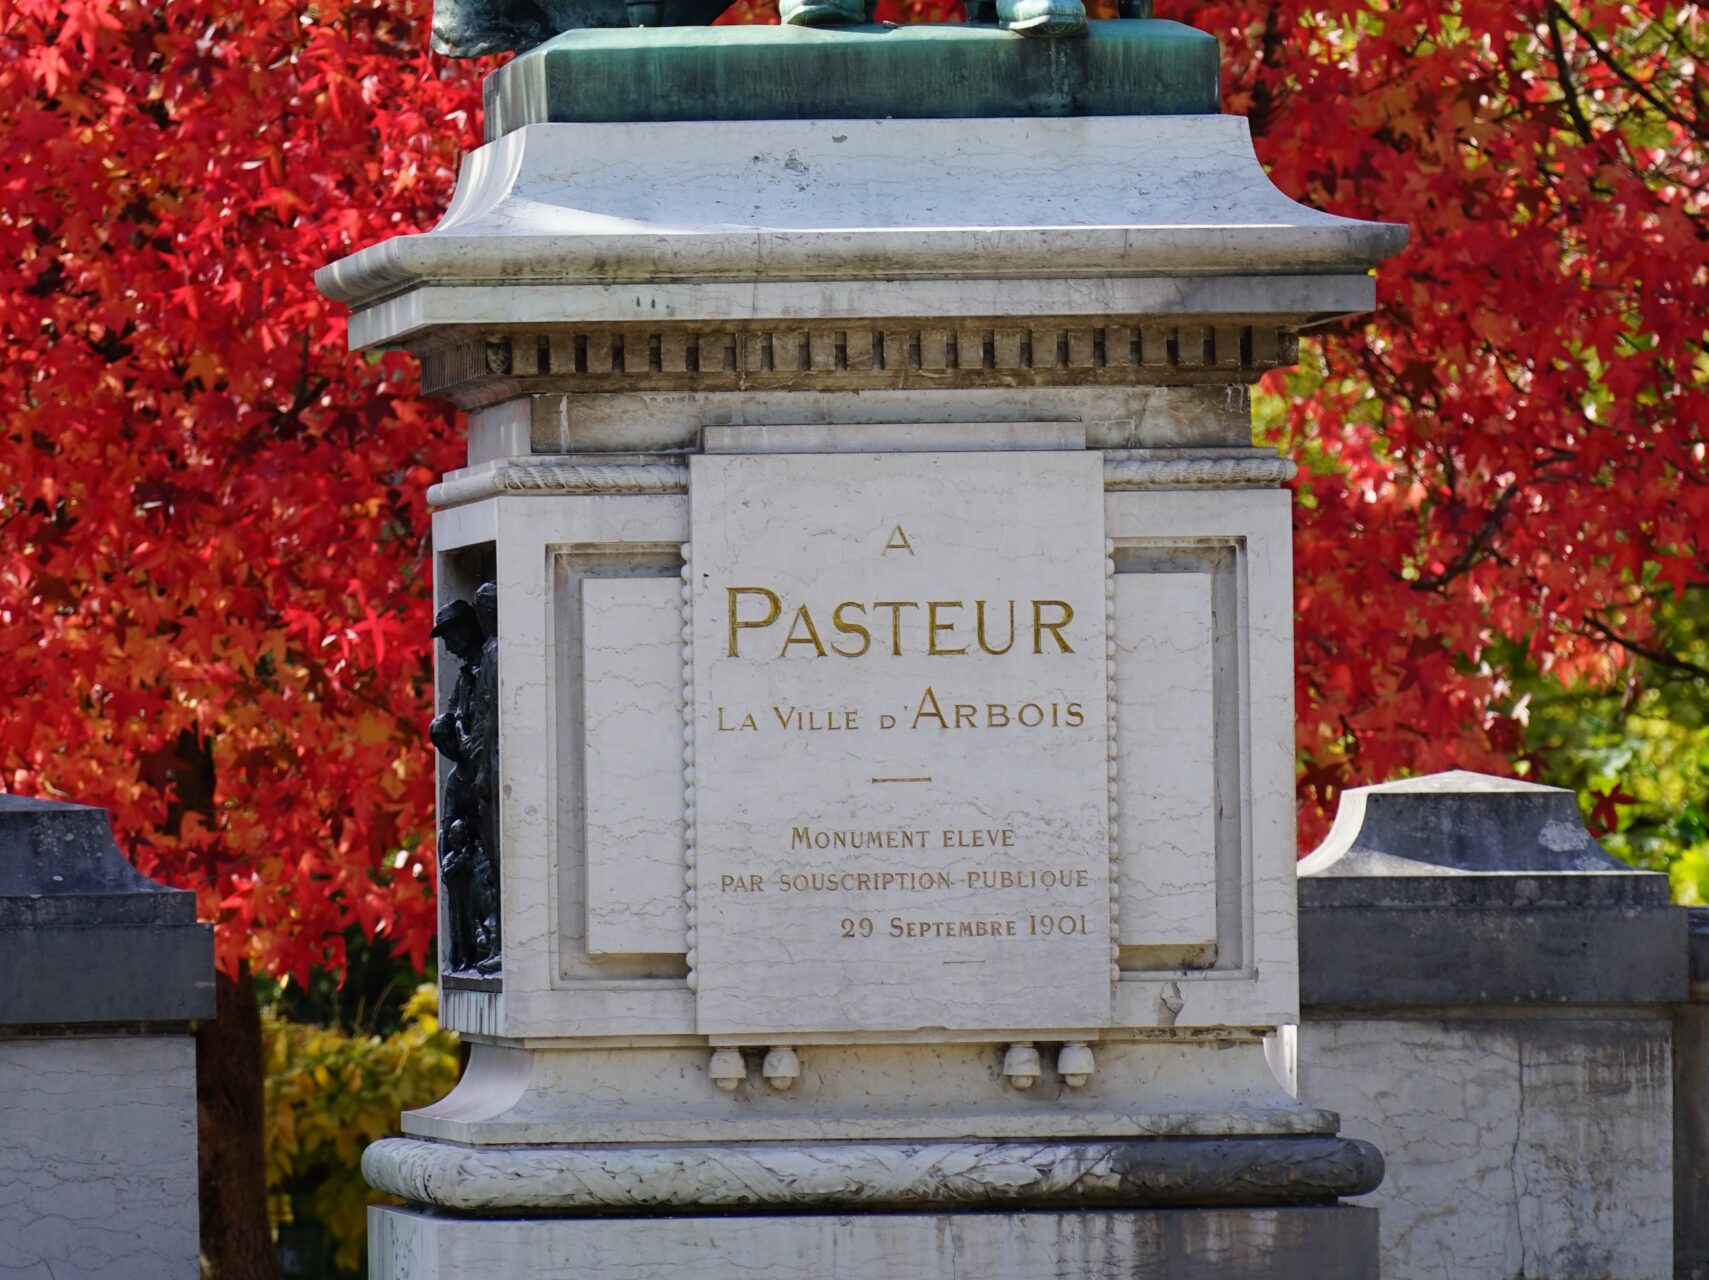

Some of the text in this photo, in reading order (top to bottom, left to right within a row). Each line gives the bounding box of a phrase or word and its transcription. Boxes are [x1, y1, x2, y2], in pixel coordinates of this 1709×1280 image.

[881, 523, 915, 556] A
[725, 586, 1076, 658] PASTEUR
[717, 706, 758, 731] LA
[772, 705, 859, 731] VILLE
[791, 826, 930, 850] MONUMENT
[721, 869, 1089, 892] PAR SOUSCRIPTION PUBLIQUE
[840, 914, 1088, 938] 29 SEPTEMBRE 1901
